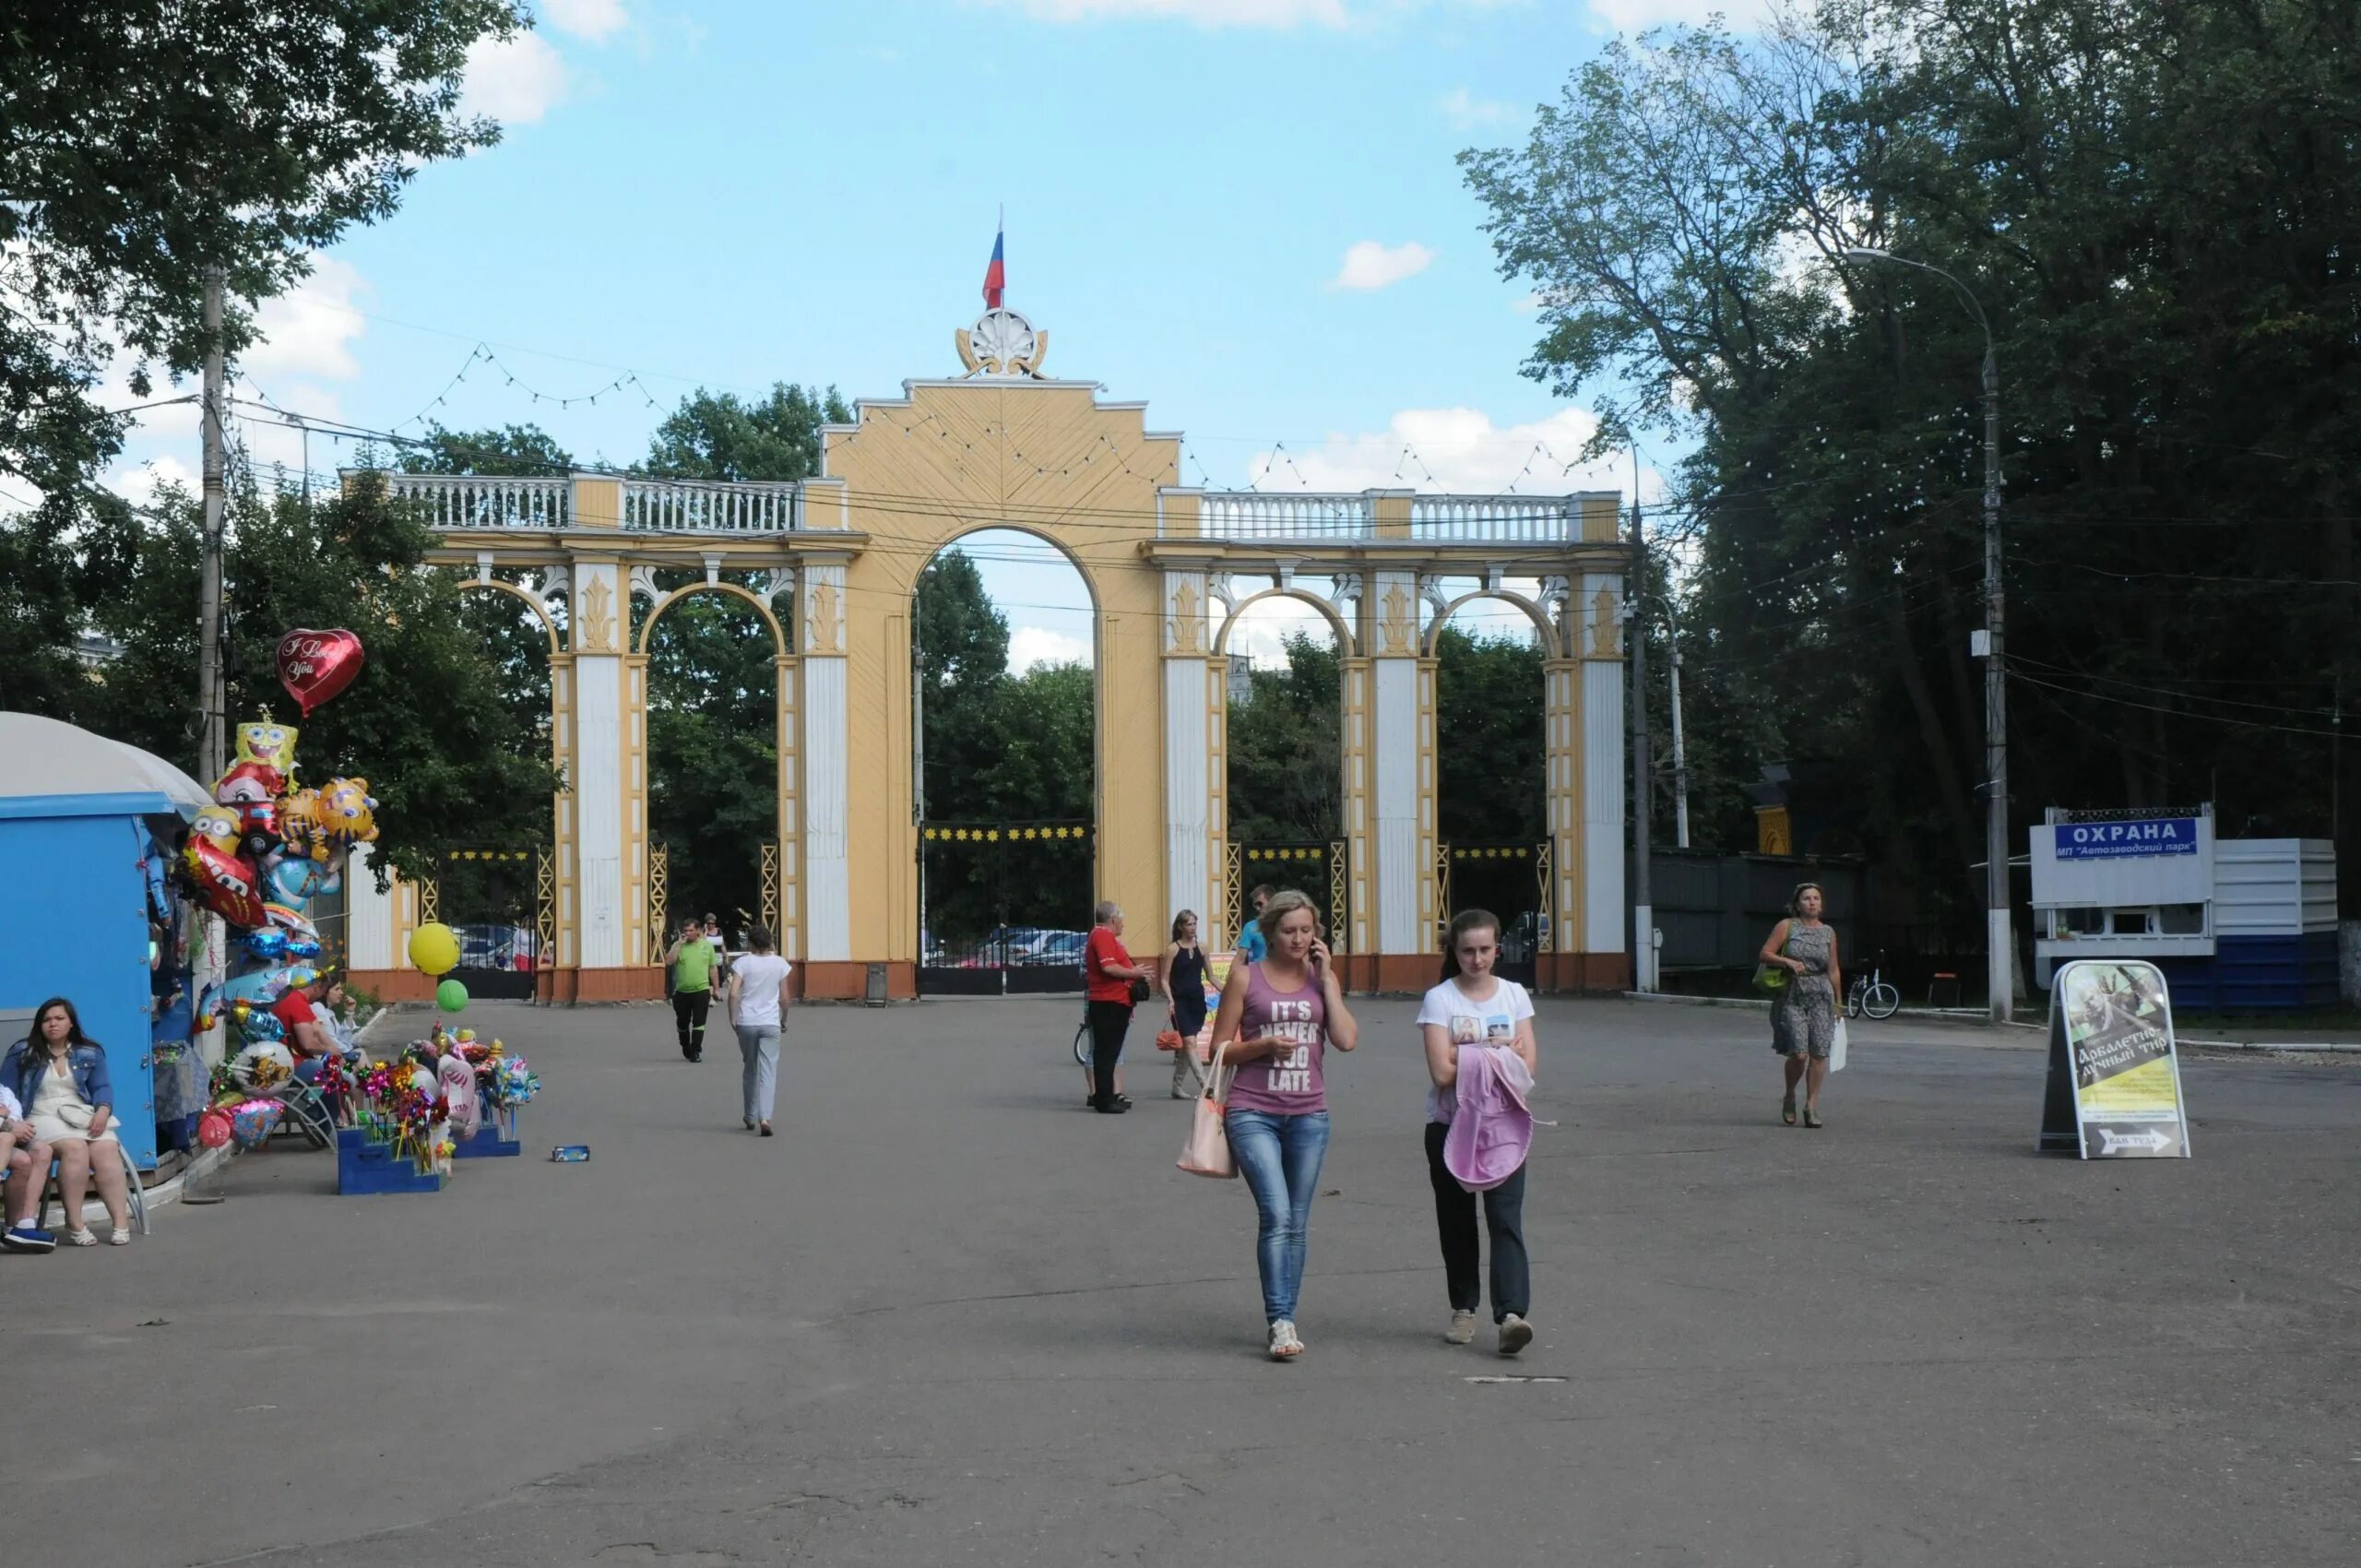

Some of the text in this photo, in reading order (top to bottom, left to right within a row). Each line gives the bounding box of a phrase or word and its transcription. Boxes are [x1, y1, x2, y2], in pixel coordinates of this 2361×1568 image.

[282, 637, 303, 656] I
[286, 661, 314, 682] You
[2073, 824, 2177, 843] ОХРАНА
[2057, 848, 2073, 856] МП
[1271, 1001, 1311, 1022] IT'S
[1268, 1069, 1311, 1092] LATE
